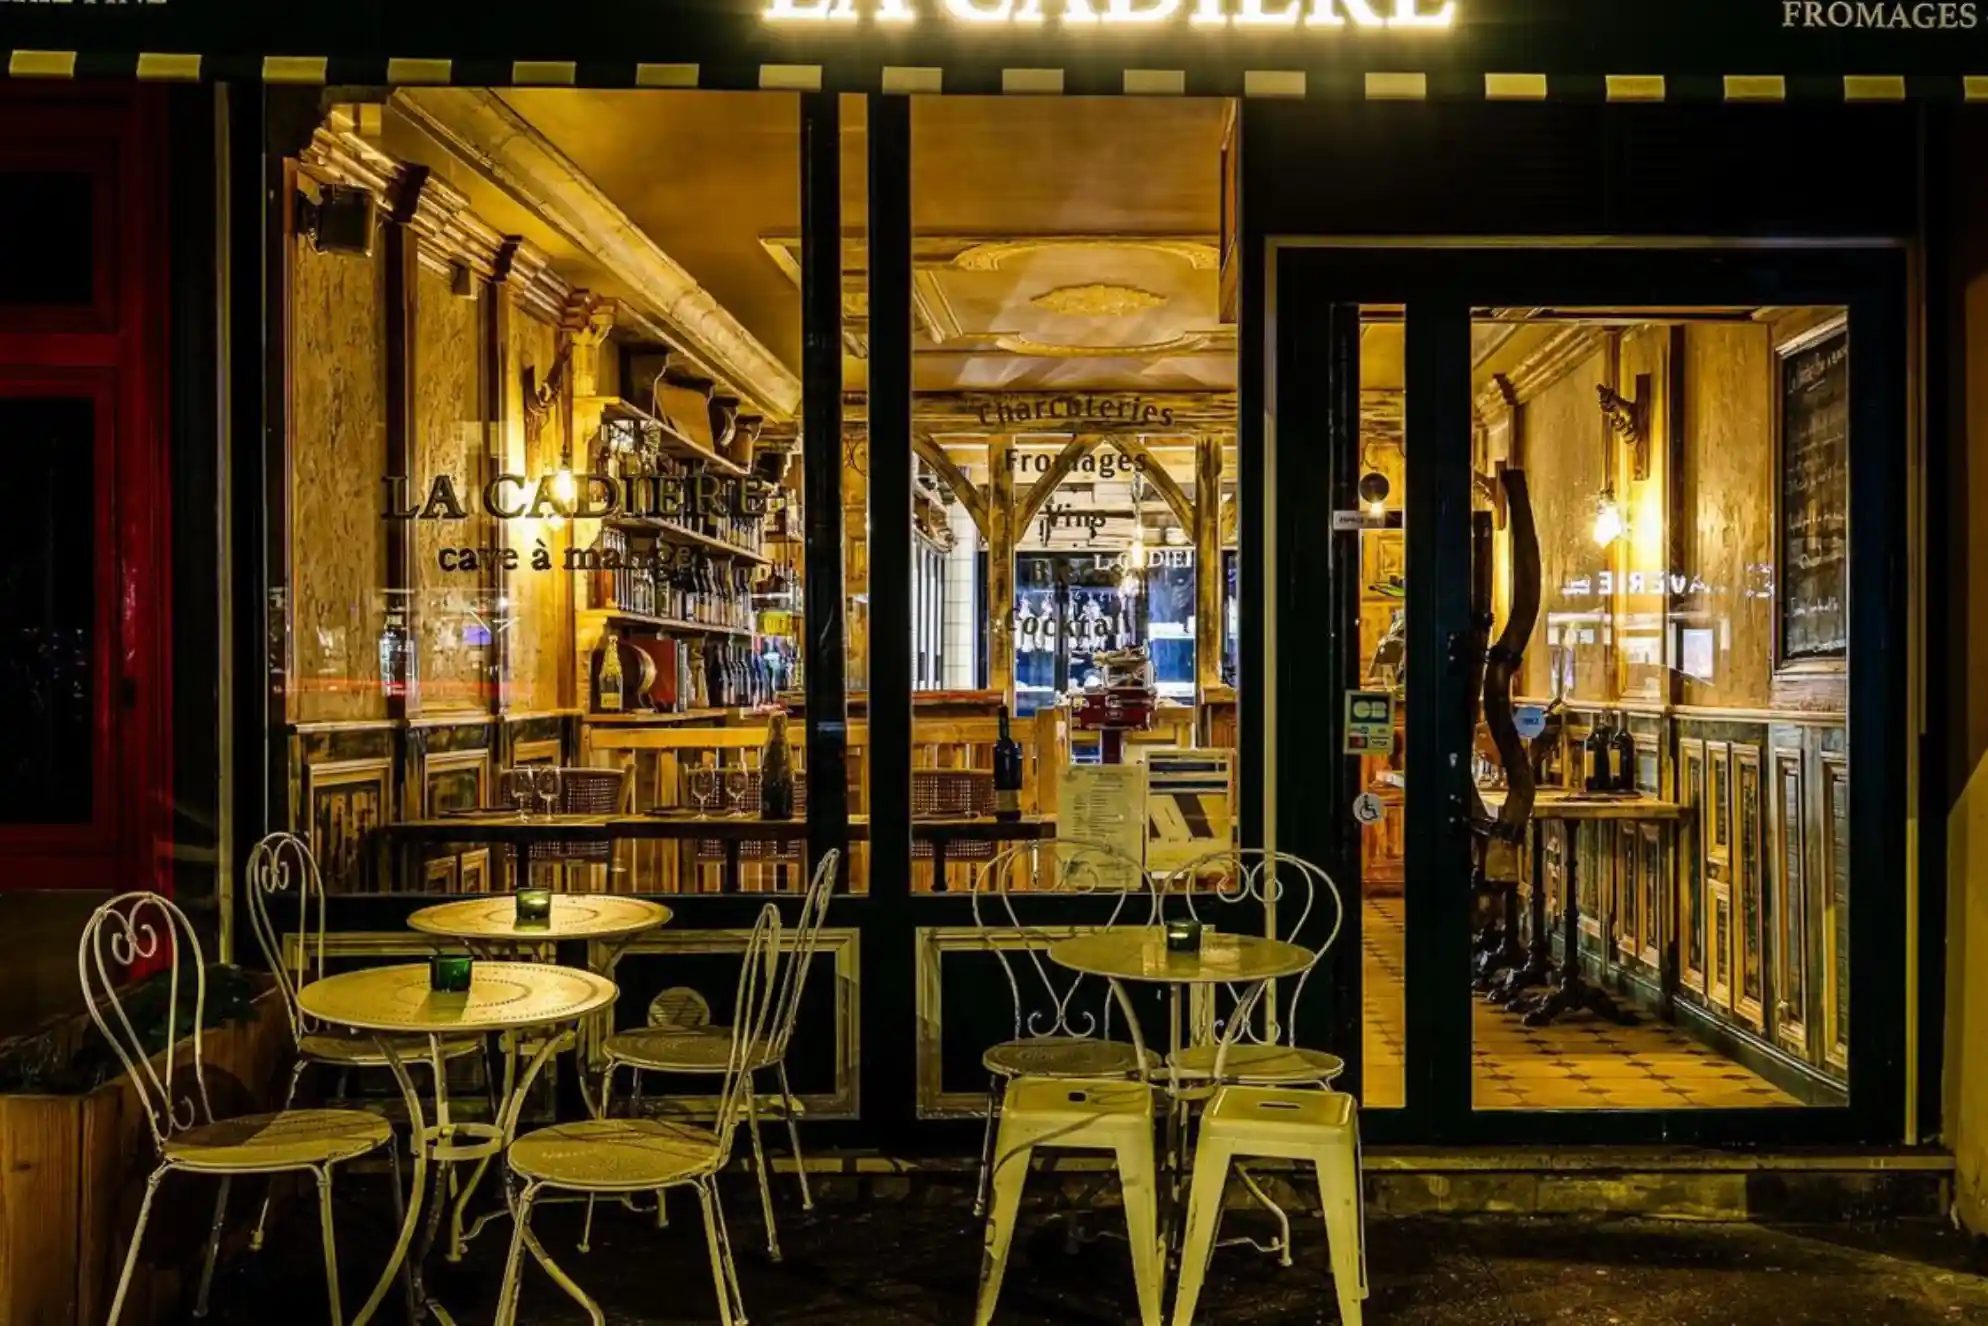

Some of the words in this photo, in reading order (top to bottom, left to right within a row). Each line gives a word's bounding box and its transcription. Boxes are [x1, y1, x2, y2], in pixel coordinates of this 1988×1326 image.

[1782, 0, 1978, 29] FROMAGES
[381, 474, 469, 520] LA
[438, 547, 519, 572] cave
[530, 537, 553, 572] à
